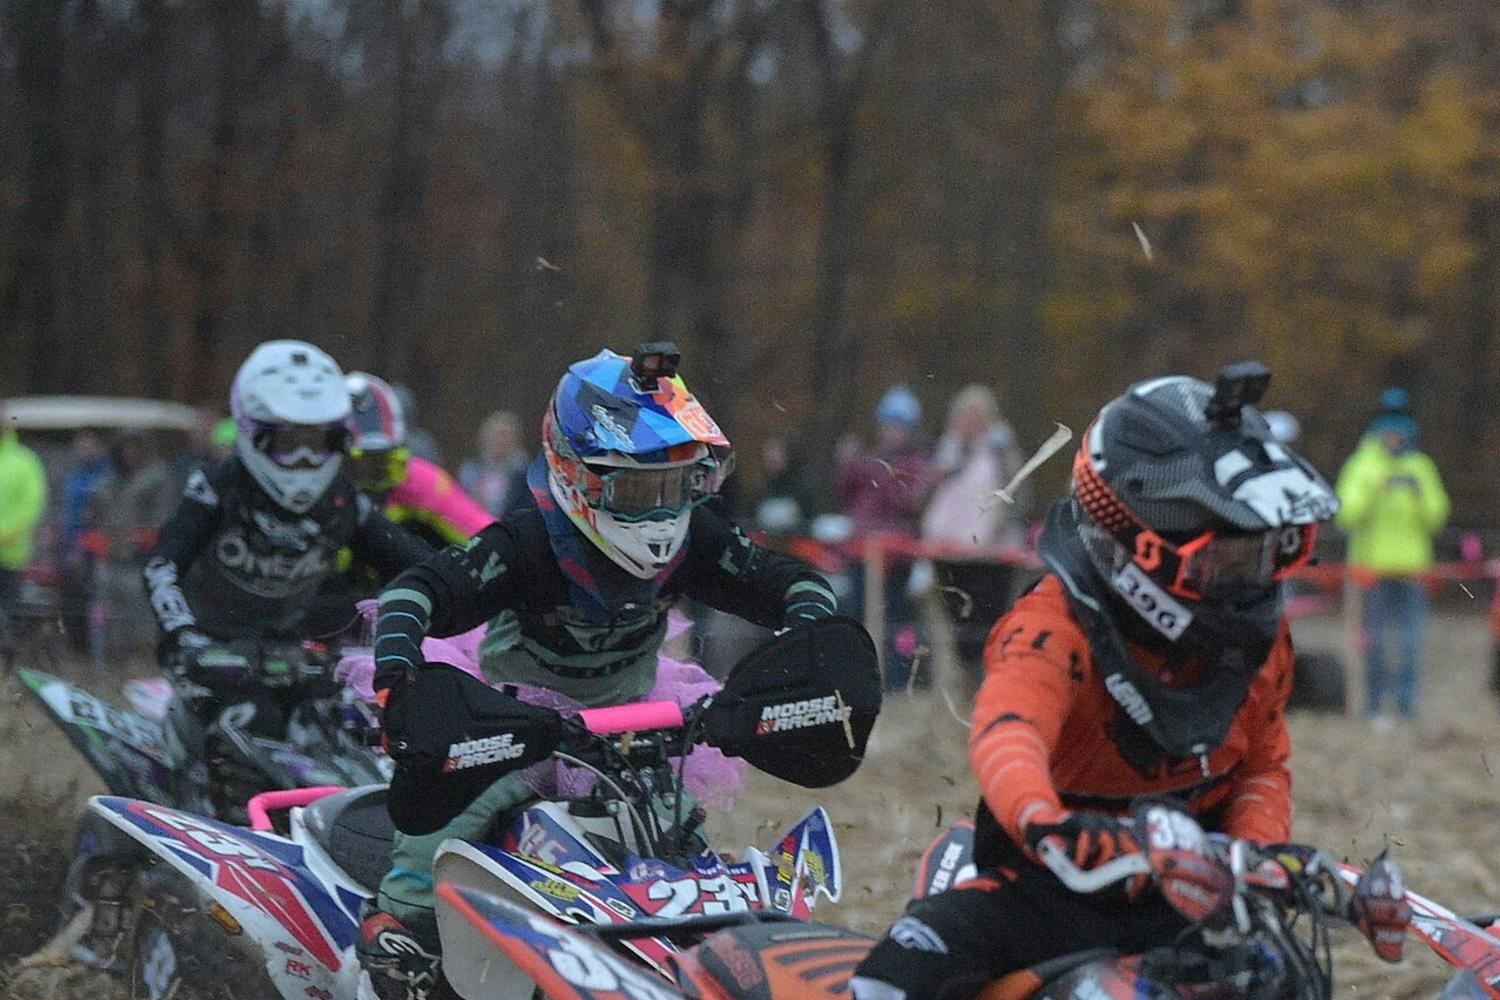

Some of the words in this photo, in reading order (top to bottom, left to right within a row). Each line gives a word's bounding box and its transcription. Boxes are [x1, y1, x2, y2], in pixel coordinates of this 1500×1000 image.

[761, 695, 837, 721] MOOSE
[449, 733, 514, 758] MOOSE
[457, 743, 527, 770] RACING
